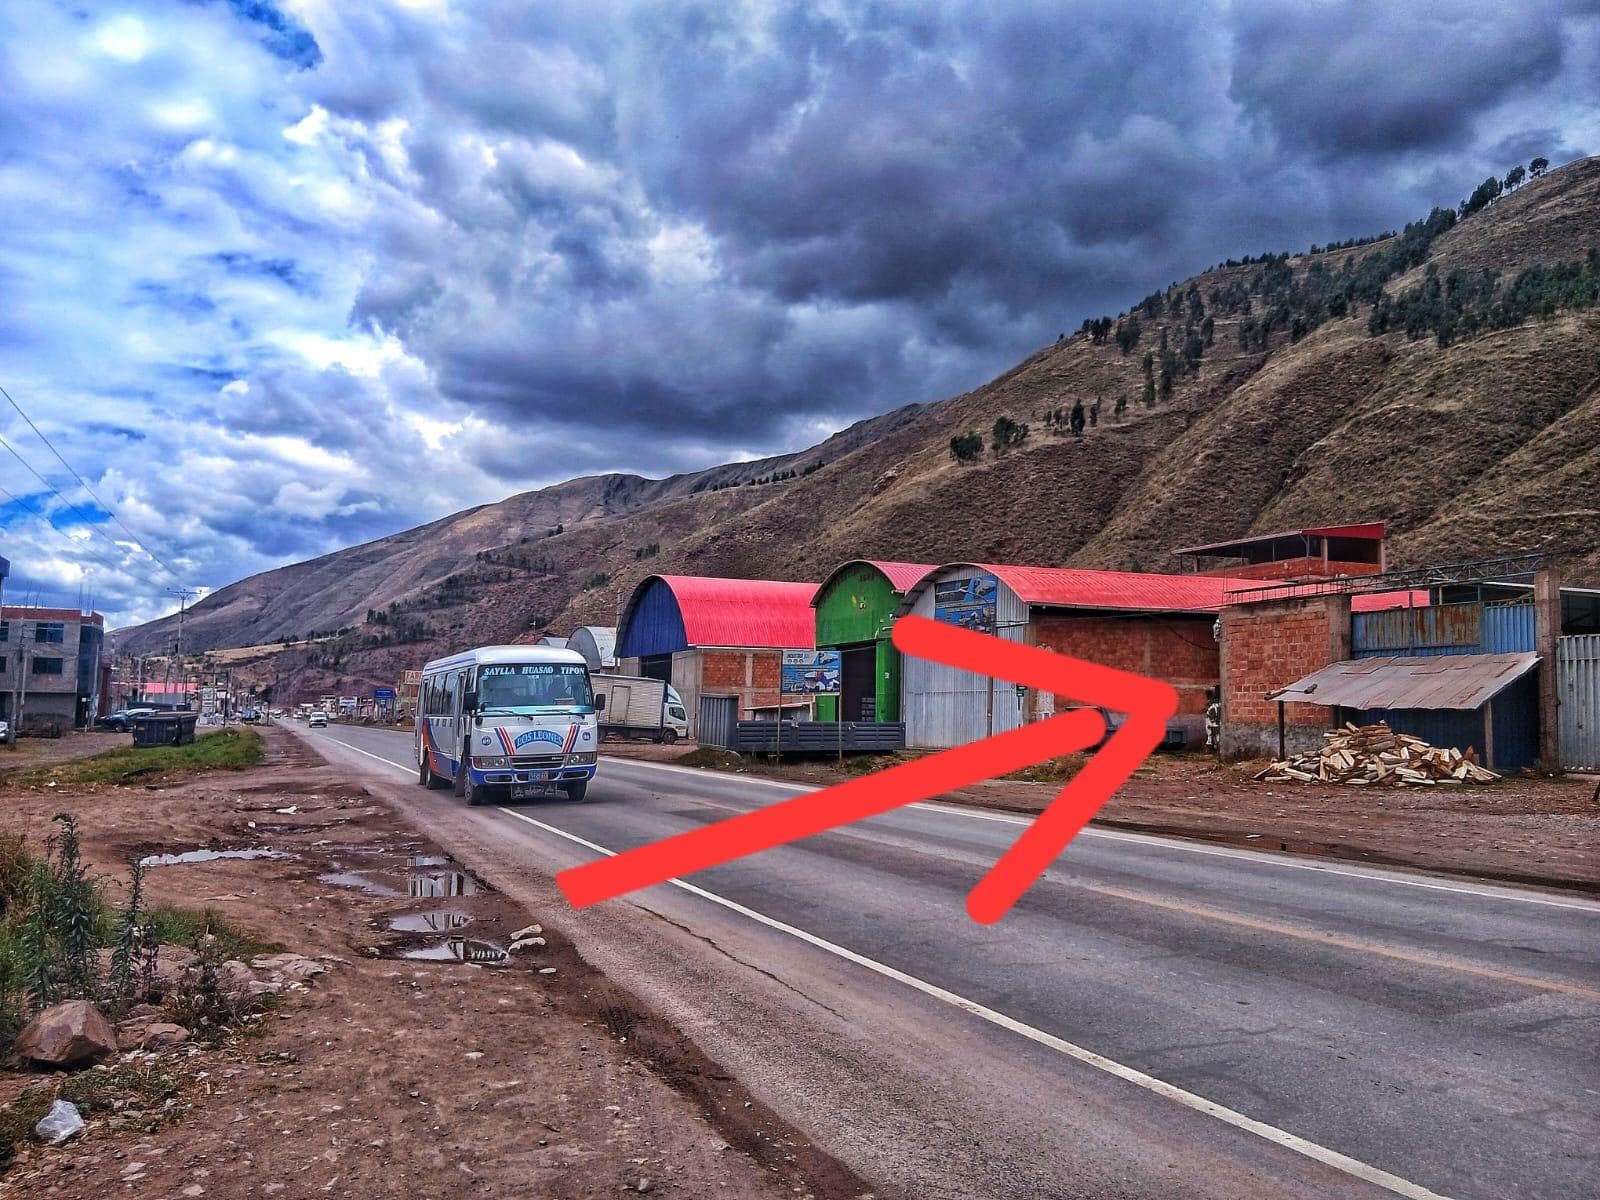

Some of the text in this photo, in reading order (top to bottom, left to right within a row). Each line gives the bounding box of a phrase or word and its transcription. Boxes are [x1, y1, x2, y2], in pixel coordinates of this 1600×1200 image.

[484, 666, 585, 676] SAYLLA HUASAO TIPON
